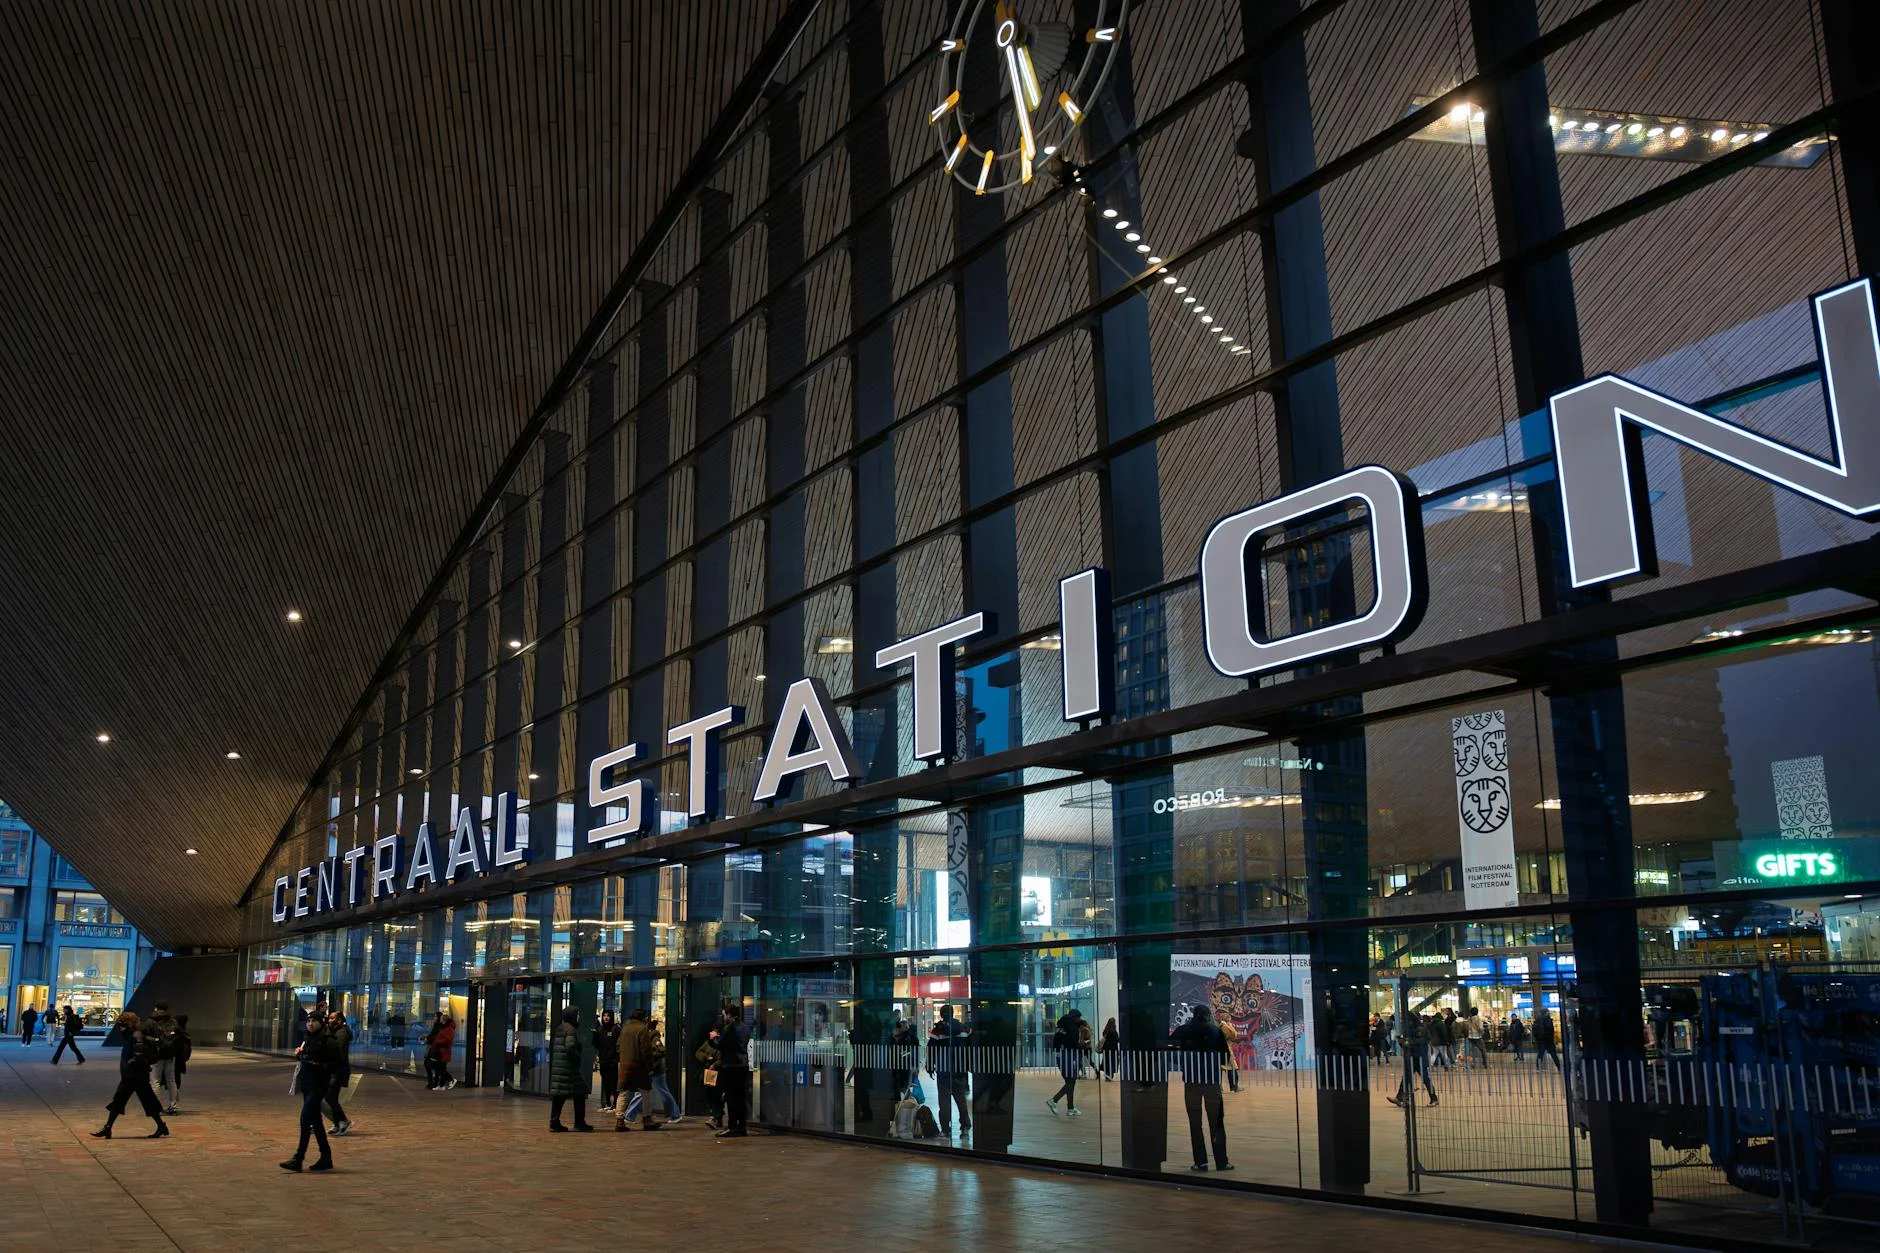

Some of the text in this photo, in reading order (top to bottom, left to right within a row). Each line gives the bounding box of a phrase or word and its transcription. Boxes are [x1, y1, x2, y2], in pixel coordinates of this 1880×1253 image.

[272, 277, 1880, 923] CENTRAAL STATION
[1465, 863, 1514, 873] INTERNATIONAL
[1756, 852, 1837, 877] GIFTS
[1483, 872, 1512, 880] FESTIVAL
[1470, 881, 1510, 889] ROTTERDAM
[1174, 959, 1216, 968] INTERNATIONAL
[1217, 958, 1239, 968] FILM
[1250, 958, 1281, 968] FESTIVAL
